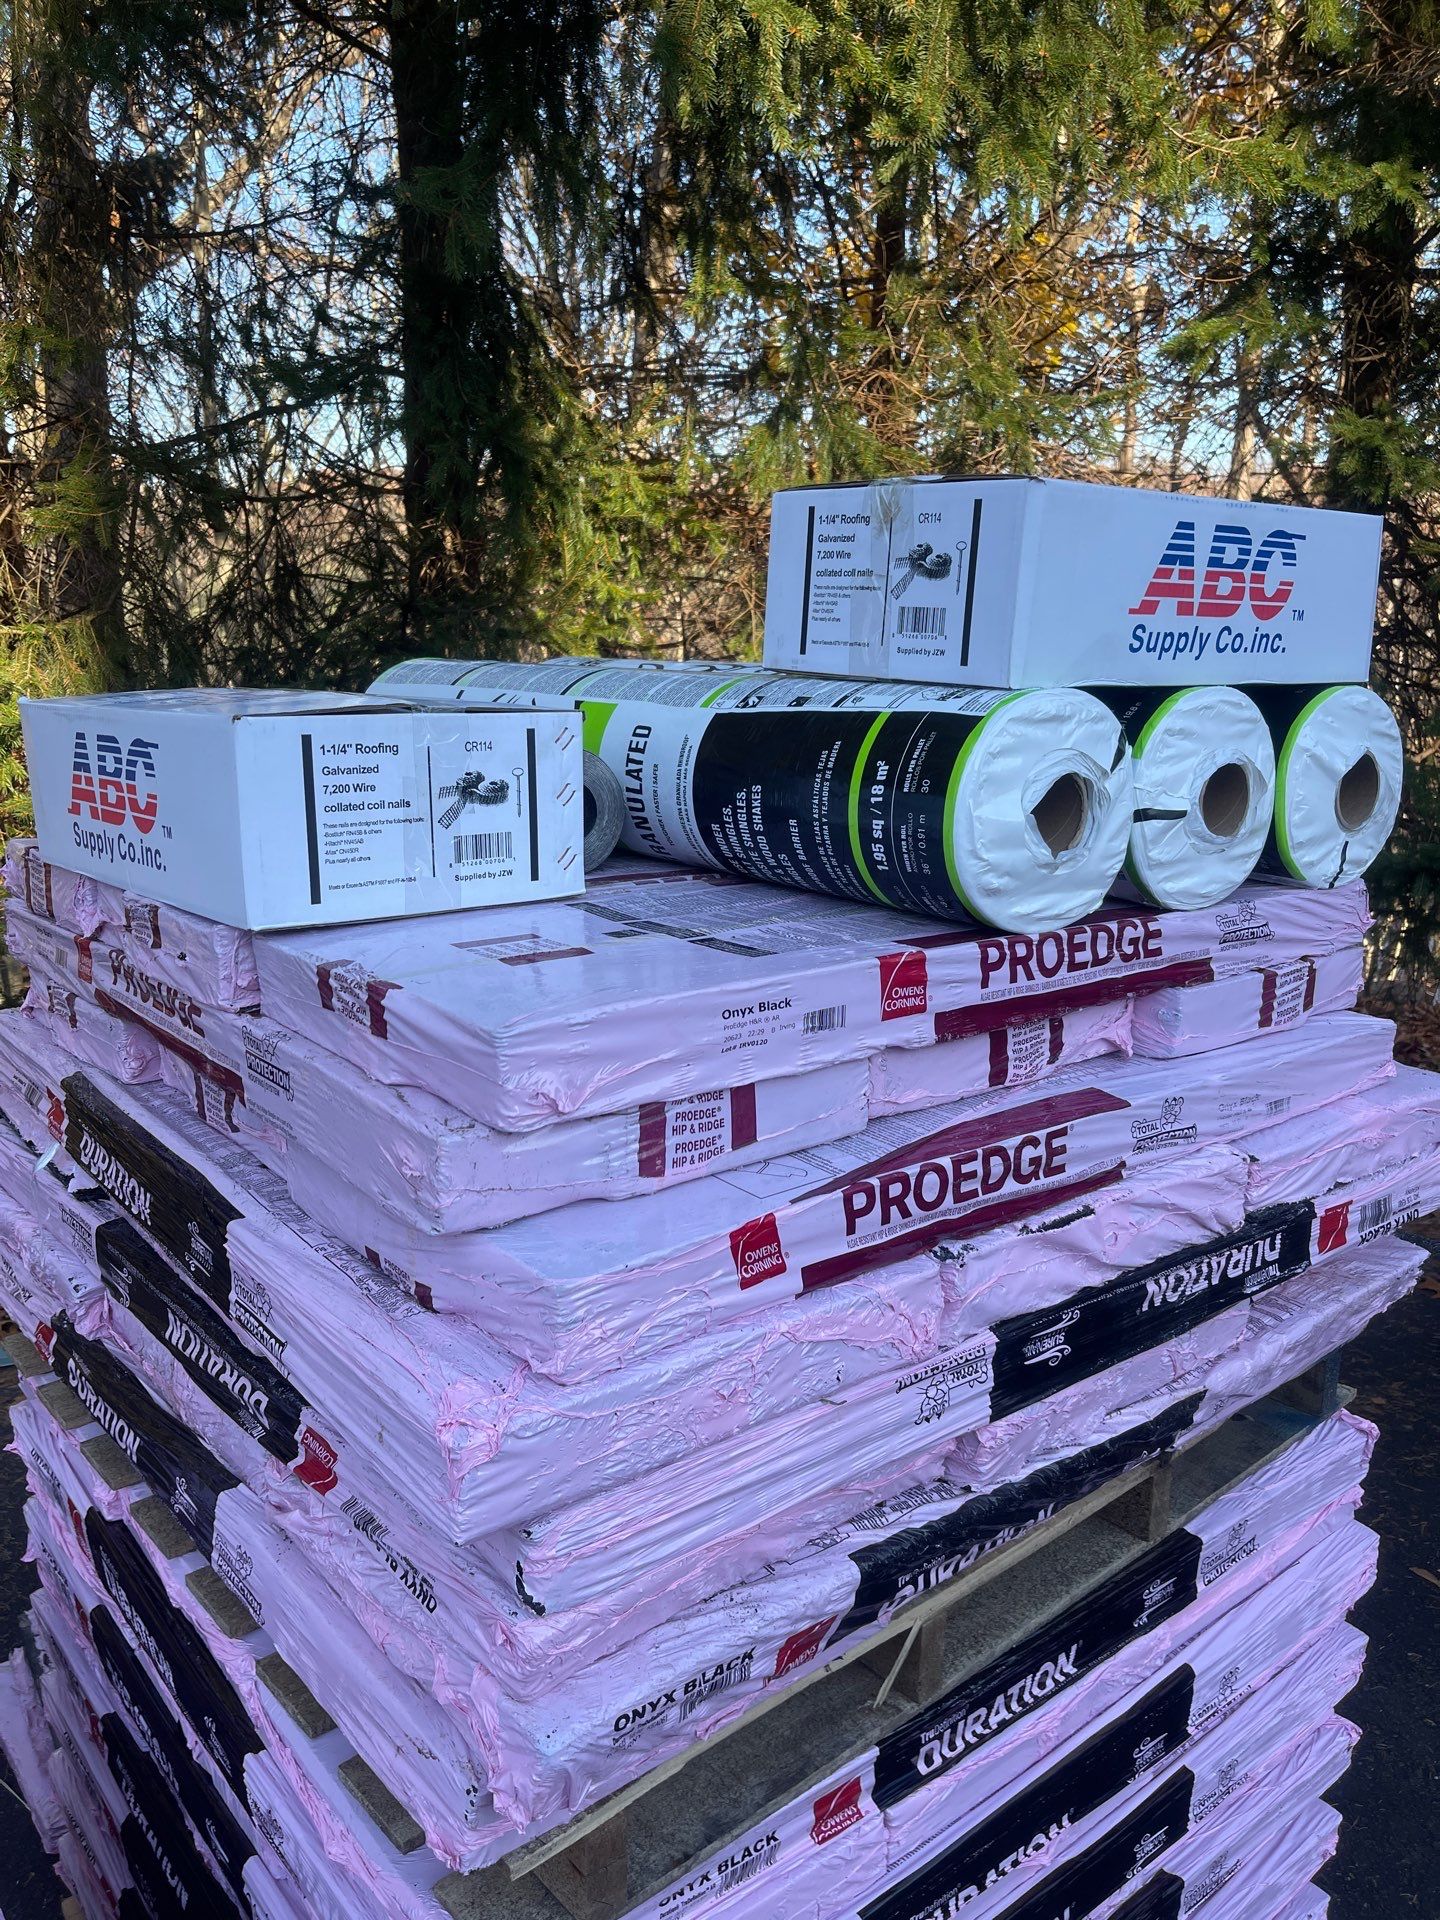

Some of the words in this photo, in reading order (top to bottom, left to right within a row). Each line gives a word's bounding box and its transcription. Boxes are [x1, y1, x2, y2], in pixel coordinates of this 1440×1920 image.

[818, 514, 839, 525] 1-1/4"
[840, 513, 871, 526] Roofing
[918, 512, 942, 524] CR114
[817, 533, 855, 543] Galvanized
[816, 550, 835, 560] 7,200
[835, 550, 852, 560] Wire
[815, 568, 843, 578] collated
[843, 568, 856, 578] coil
[856, 568, 874, 578] nails
[1128, 520, 1307, 621] ABC
[896, 646, 923, 656] Supplied
[923, 649, 931, 657] by
[1128, 623, 1212, 661] Supply
[319, 743, 353, 756] 1-1/4"
[355, 742, 399, 756] Roofing
[464, 740, 493, 752] CR114
[827, 740, 842, 769] MADERA
[911, 738, 927, 759] PALLET
[321, 764, 380, 776] Galvanized
[817, 750, 829, 770] TEJAS
[907, 759, 917, 772] PER
[910, 766, 922, 793] ROLLOS
[917, 751, 928, 766] POR
[923, 731, 938, 751] PALLET
[67, 731, 159, 835] ABC
[652, 763, 660, 785] SAFER
[825, 770, 834, 779] DE
[903, 773, 913, 793] ROLLS
[322, 783, 351, 795] 7,200
[352, 783, 377, 793] Wire
[869, 785, 885, 804] 18
[920, 778, 931, 794] 30
[323, 801, 365, 813] collated
[366, 800, 385, 810] coil
[387, 799, 411, 809] nails
[652, 789, 661, 814] FASTER
[751, 784, 764, 832] SHAKES
[821, 782, 830, 815] TEJADOS
[357, 820, 379, 828] designed
[736, 788, 754, 848] SHINGLES,
[918, 814, 926, 824] m
[722, 804, 746, 859] SHINGLES,
[812, 821, 823, 844] TEJAS
[870, 819, 885, 839] sq
[917, 828, 927, 849] 0.91
[73, 821, 114, 863] Supply
[710, 823, 734, 858] UNDER
[788, 819, 808, 861] BARRIER
[821, 825, 835, 856] PIZARRA
[900, 840, 908, 853] PER
[907, 836, 915, 851] POR
[335, 857, 351, 865] nearly
[756, 836, 778, 866] WOOD
[871, 843, 890, 872] 1.95
[454, 872, 487, 882] Supplied
[487, 871, 497, 880] by
[497, 869, 514, 877] JZW
[1220, 924, 1271, 944] PROTECTION
[1221, 918, 1239, 929] TOTAL
[975, 916, 1163, 990] PROEDGE
[892, 985, 925, 999] OWENS
[721, 1005, 755, 1020] Onyx
[758, 997, 793, 1013] Black
[884, 995, 925, 1011] CORNING
[723, 1020, 748, 1031] ProEdge
[749, 1017, 763, 1025] H&R
[771, 1014, 781, 1022] AR
[747, 1028, 765, 1038] 22:29
[779, 1022, 796, 1032] Irving
[1011, 1031, 1023, 1039] HIP
[1028, 1023, 1046, 1034] RIDGE
[721, 1043, 737, 1054] Lot#
[1011, 1047, 1024, 1055] HIP
[246, 1053, 291, 1092] PROTECTION
[696, 1090, 724, 1103] RIDGE
[671, 1124, 687, 1136] HIP
[689, 1123, 696, 1134] &
[698, 1118, 725, 1133] RIDGE
[1137, 1122, 1160, 1135] TOTAL
[1134, 1127, 1197, 1151] PROTECTION
[671, 1156, 687, 1169] HIP
[689, 1154, 696, 1165] &
[697, 1145, 725, 1161] RIDGE
[79, 1129, 151, 1226] DURATION
[1357, 1221, 1392, 1247] BLACK
[745, 1242, 779, 1263] OWENS
[741, 1253, 783, 1278] CORNING
[1138, 1232, 1282, 1313] DURATION
[238, 1283, 257, 1309] TOTAL
[164, 1307, 270, 1431] DURATION
[66, 1357, 141, 1463] DURATION
[1204, 1552, 1225, 1568] TOTAL
[399, 1569, 438, 1614] ONYX
[613, 1688, 677, 1732] ONYX
[683, 1645, 757, 1696] BLACK
[915, 1642, 1079, 1777] DURATION
[919, 1707, 967, 1743] TruDefinition
[819, 1805, 858, 1831] OWENS
[658, 1870, 713, 1908] ONYX
[716, 1829, 781, 1876] BLACK
